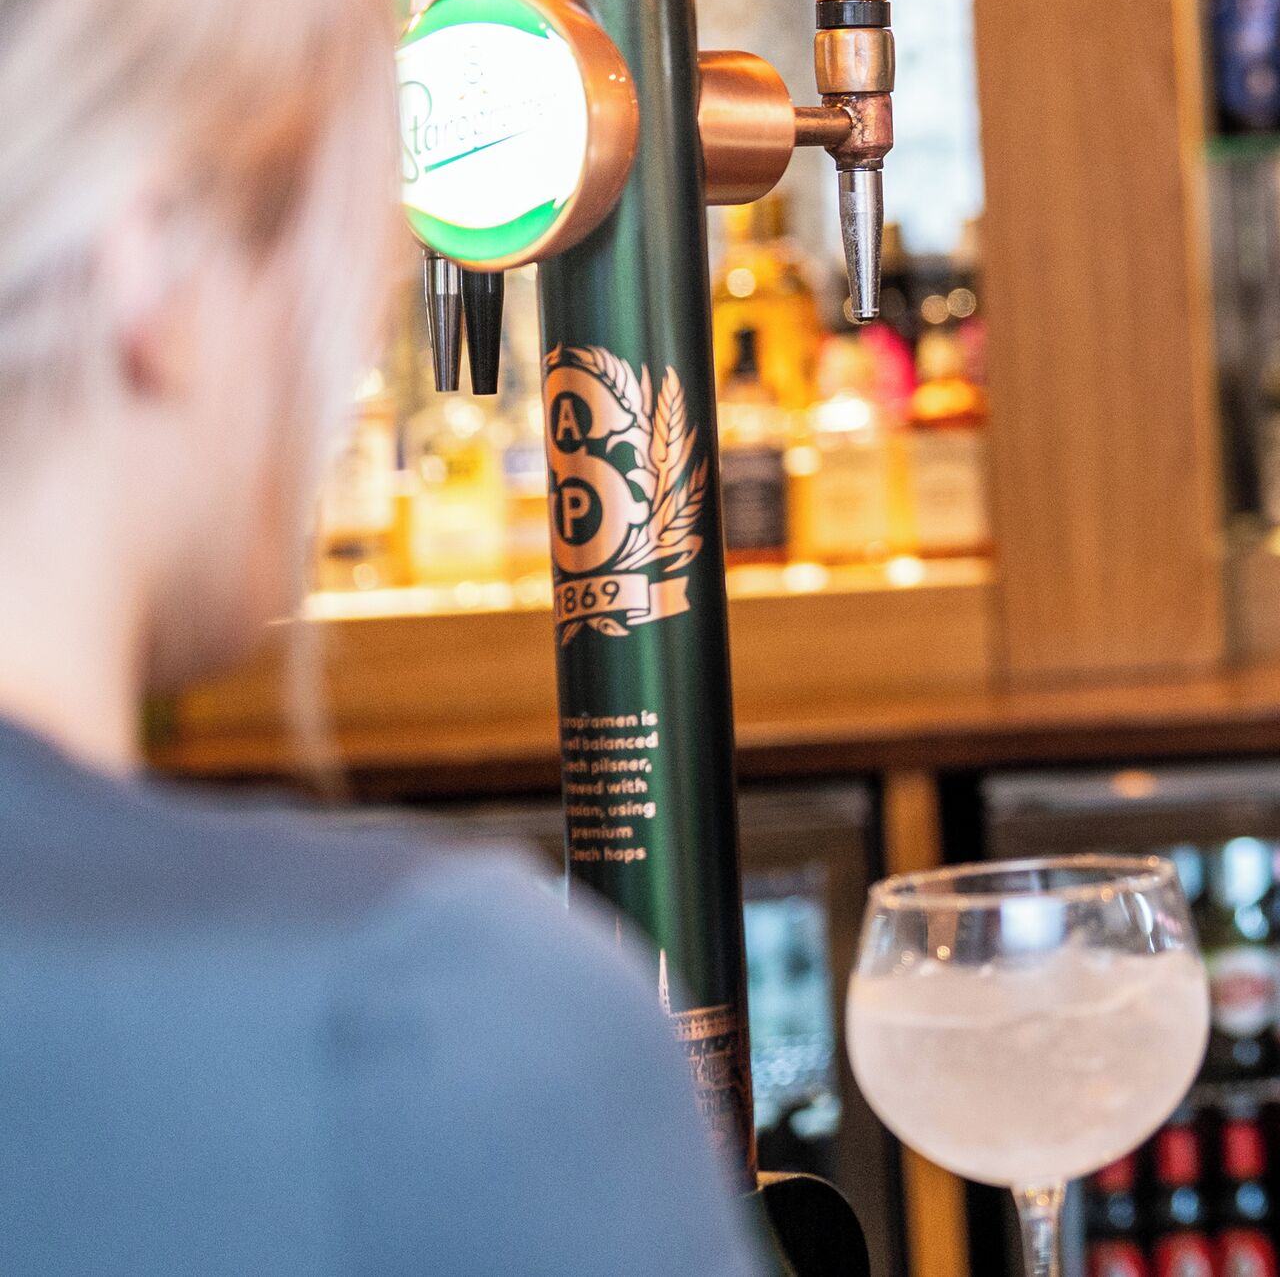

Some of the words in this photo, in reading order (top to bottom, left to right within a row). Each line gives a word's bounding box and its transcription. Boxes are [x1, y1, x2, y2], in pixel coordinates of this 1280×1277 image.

[641, 710, 658, 726] is
[583, 731, 659, 751] balanced
[591, 757, 652, 775] pilsner,
[607, 777, 648, 794] with
[608, 801, 657, 819] using
[571, 824, 634, 841] premium
[603, 845, 647, 864] hops
